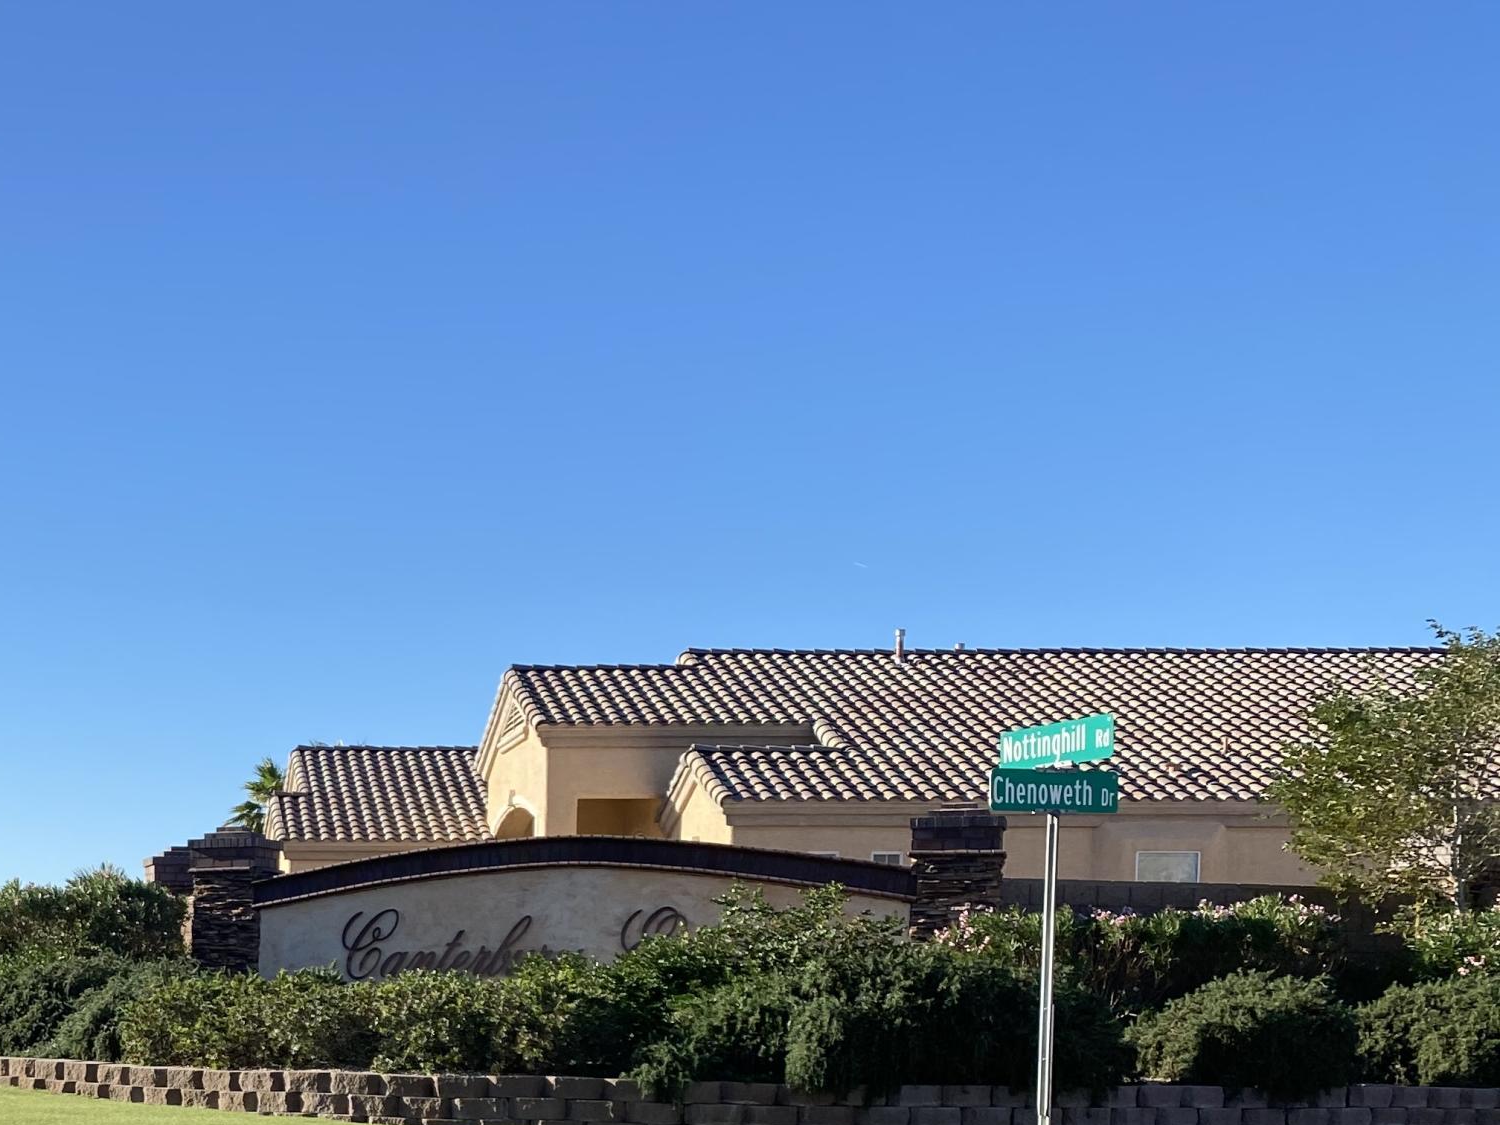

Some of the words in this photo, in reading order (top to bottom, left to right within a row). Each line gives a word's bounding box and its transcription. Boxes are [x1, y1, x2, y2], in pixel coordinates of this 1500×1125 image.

[1003, 724, 1086, 763] Nottinghill
[1095, 728, 1110, 748] Rd
[993, 775, 1093, 806] Chenoweth
[1101, 790, 1114, 807] Dr
